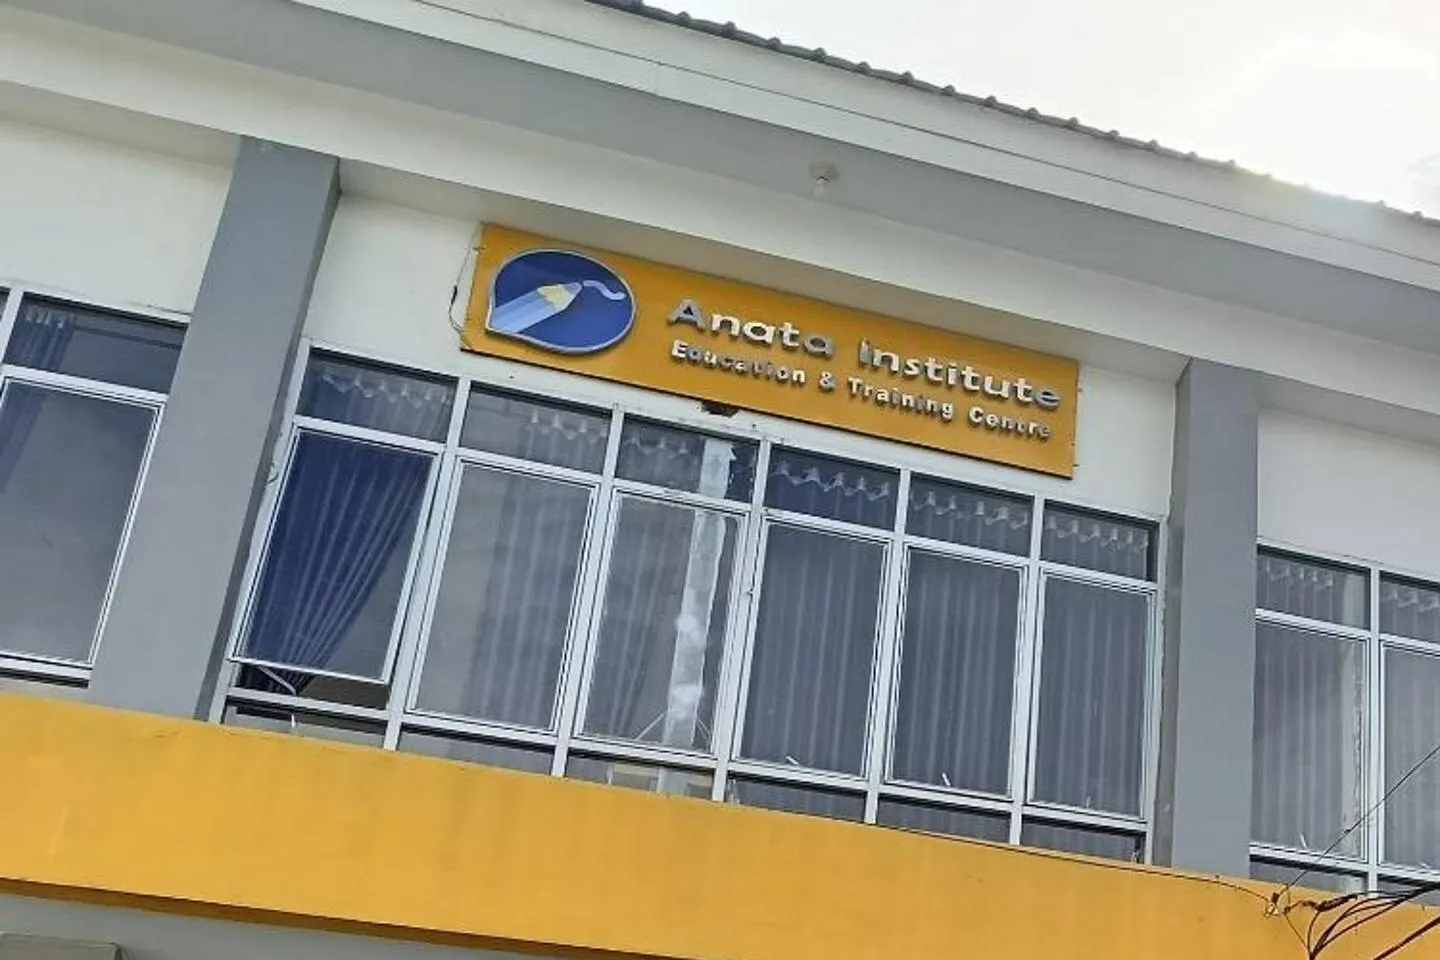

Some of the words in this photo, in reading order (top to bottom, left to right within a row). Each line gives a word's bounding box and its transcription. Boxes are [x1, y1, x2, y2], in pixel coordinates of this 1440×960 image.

[667, 299, 834, 359] Anata
[859, 337, 1060, 409] Institute
[671, 338, 806, 386] Education
[819, 370, 836, 393] &
[848, 375, 955, 423] Training
[968, 405, 1051, 440] Centre
